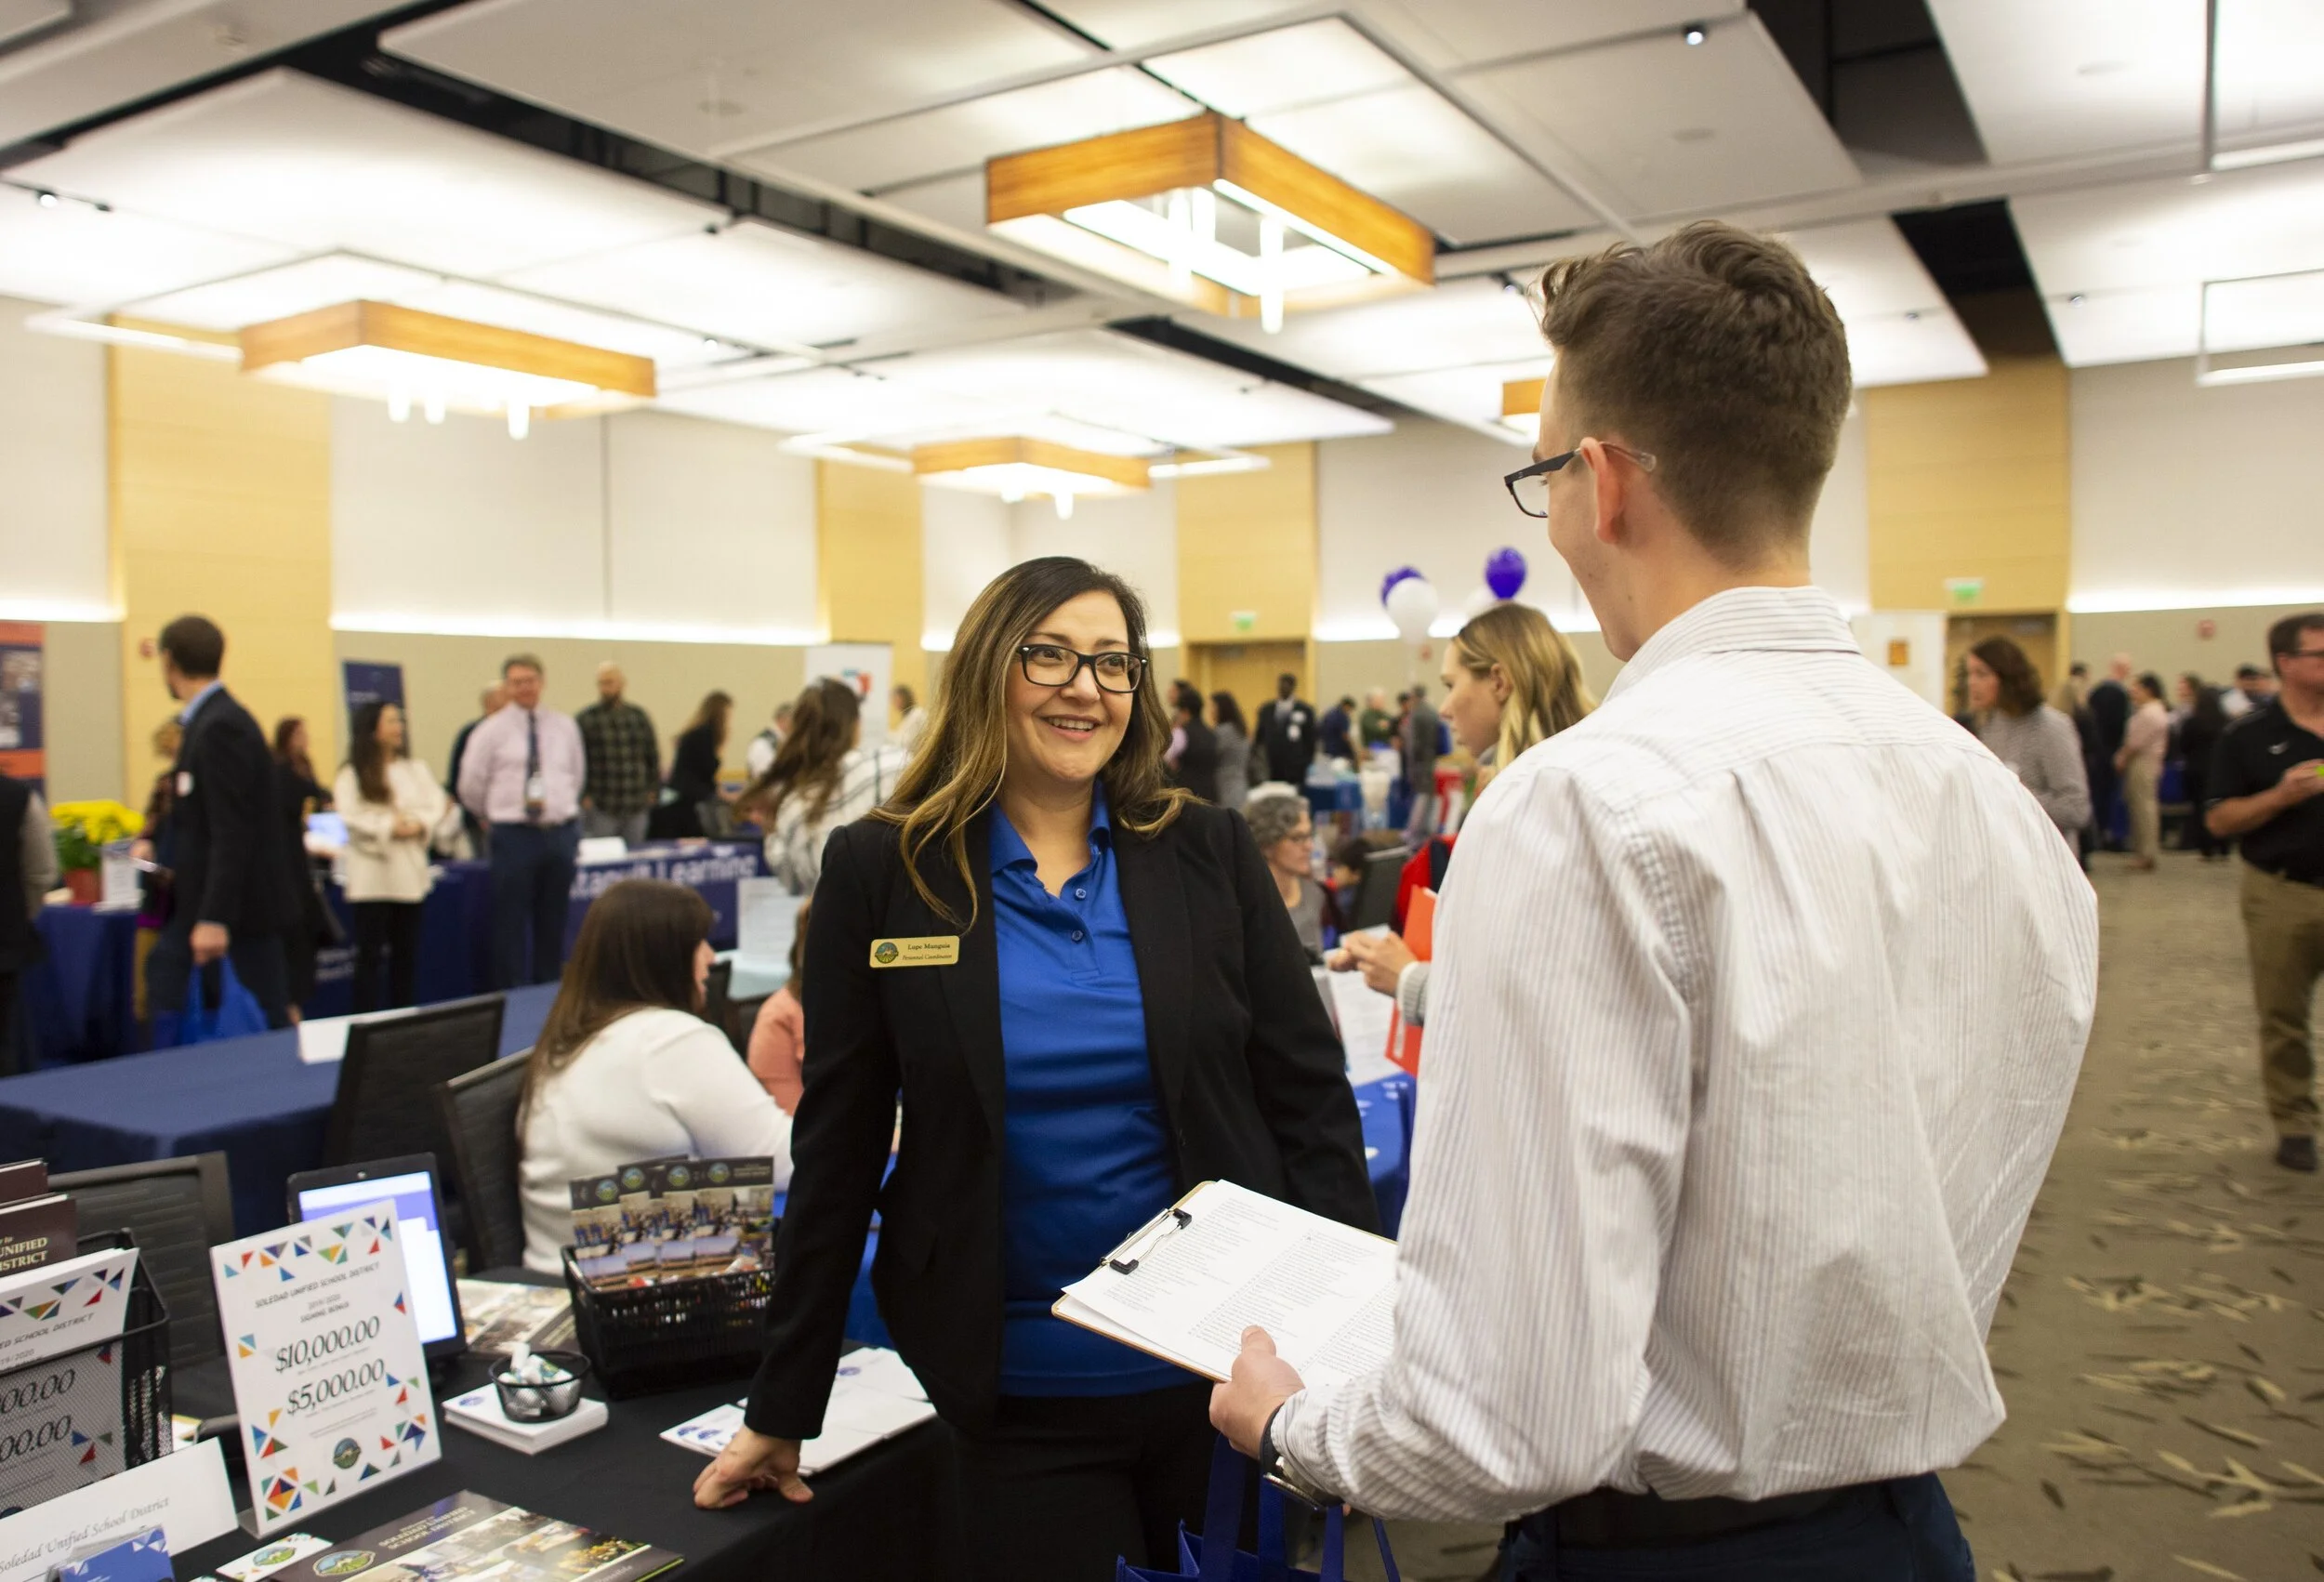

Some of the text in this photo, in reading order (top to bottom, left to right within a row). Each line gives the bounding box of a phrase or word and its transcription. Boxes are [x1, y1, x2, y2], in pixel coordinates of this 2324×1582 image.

[907, 943, 922, 951] Lupe
[255, 1290, 289, 1309] SOLEDAD
[290, 1281, 319, 1298] UNIFIED
[320, 1272, 347, 1288] SCHOOL
[14, 1327, 48, 1345] SCHOOL
[52, 1312, 95, 1332] DISTRICT
[275, 1315, 380, 1374] $10,000.00
[287, 1358, 385, 1416] $5,000.00
[45, 1523, 90, 1554] Unified
[91, 1508, 128, 1537] School
[131, 1496, 169, 1521] District
